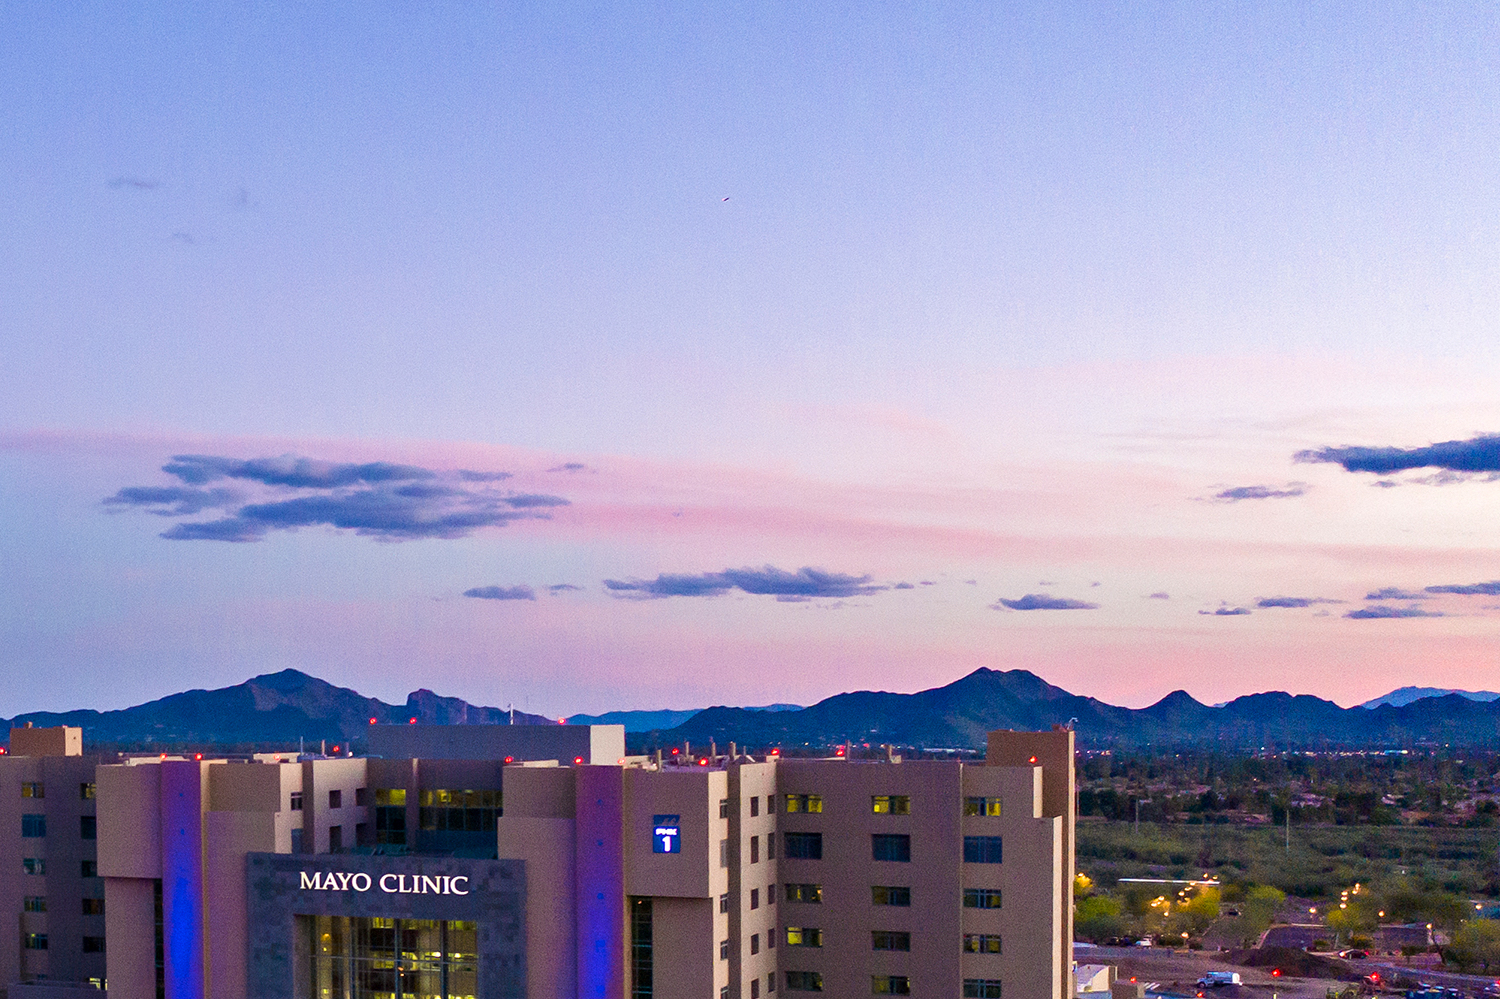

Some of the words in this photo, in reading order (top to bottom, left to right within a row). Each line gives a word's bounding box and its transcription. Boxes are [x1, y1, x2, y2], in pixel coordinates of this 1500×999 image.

[662, 836, 671, 852] 1
[300, 871, 372, 892] MAYO
[379, 873, 469, 895] CLINIC
